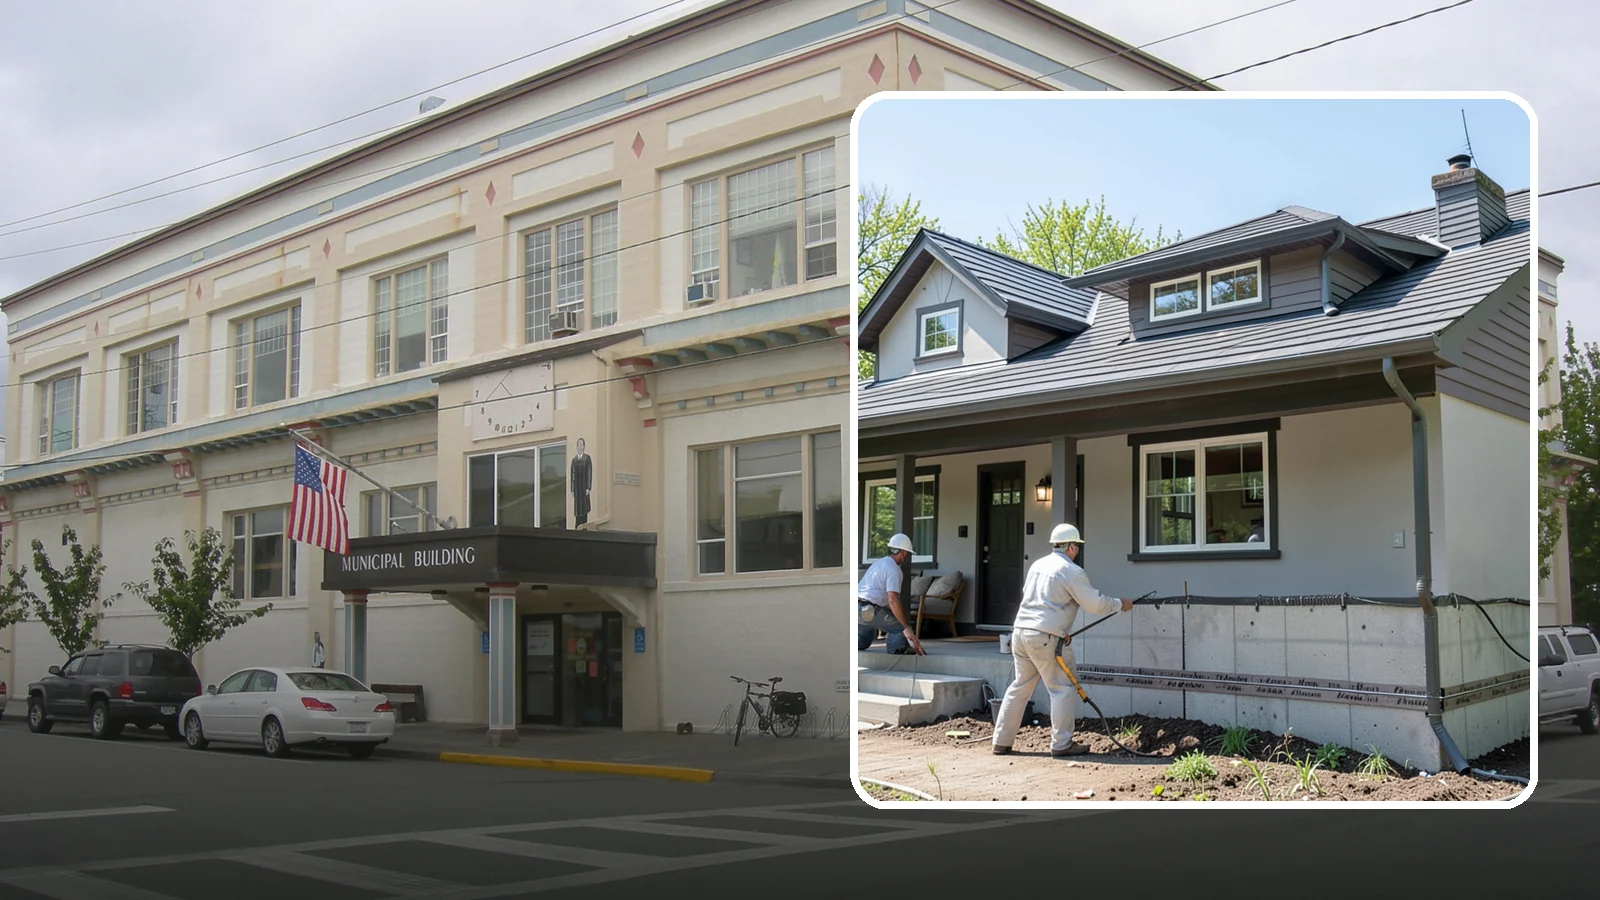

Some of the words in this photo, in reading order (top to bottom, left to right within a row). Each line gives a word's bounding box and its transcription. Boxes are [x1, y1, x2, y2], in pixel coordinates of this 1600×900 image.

[475, 390, 479, 398] 7
[480, 407, 485, 415] 8
[488, 418, 492, 426] 9
[529, 414, 533, 422] 3
[494, 424, 500, 432] 10
[508, 426, 513, 434] 12
[342, 553, 405, 571] MUNICIPAL
[414, 546, 475, 567] BUILDING
